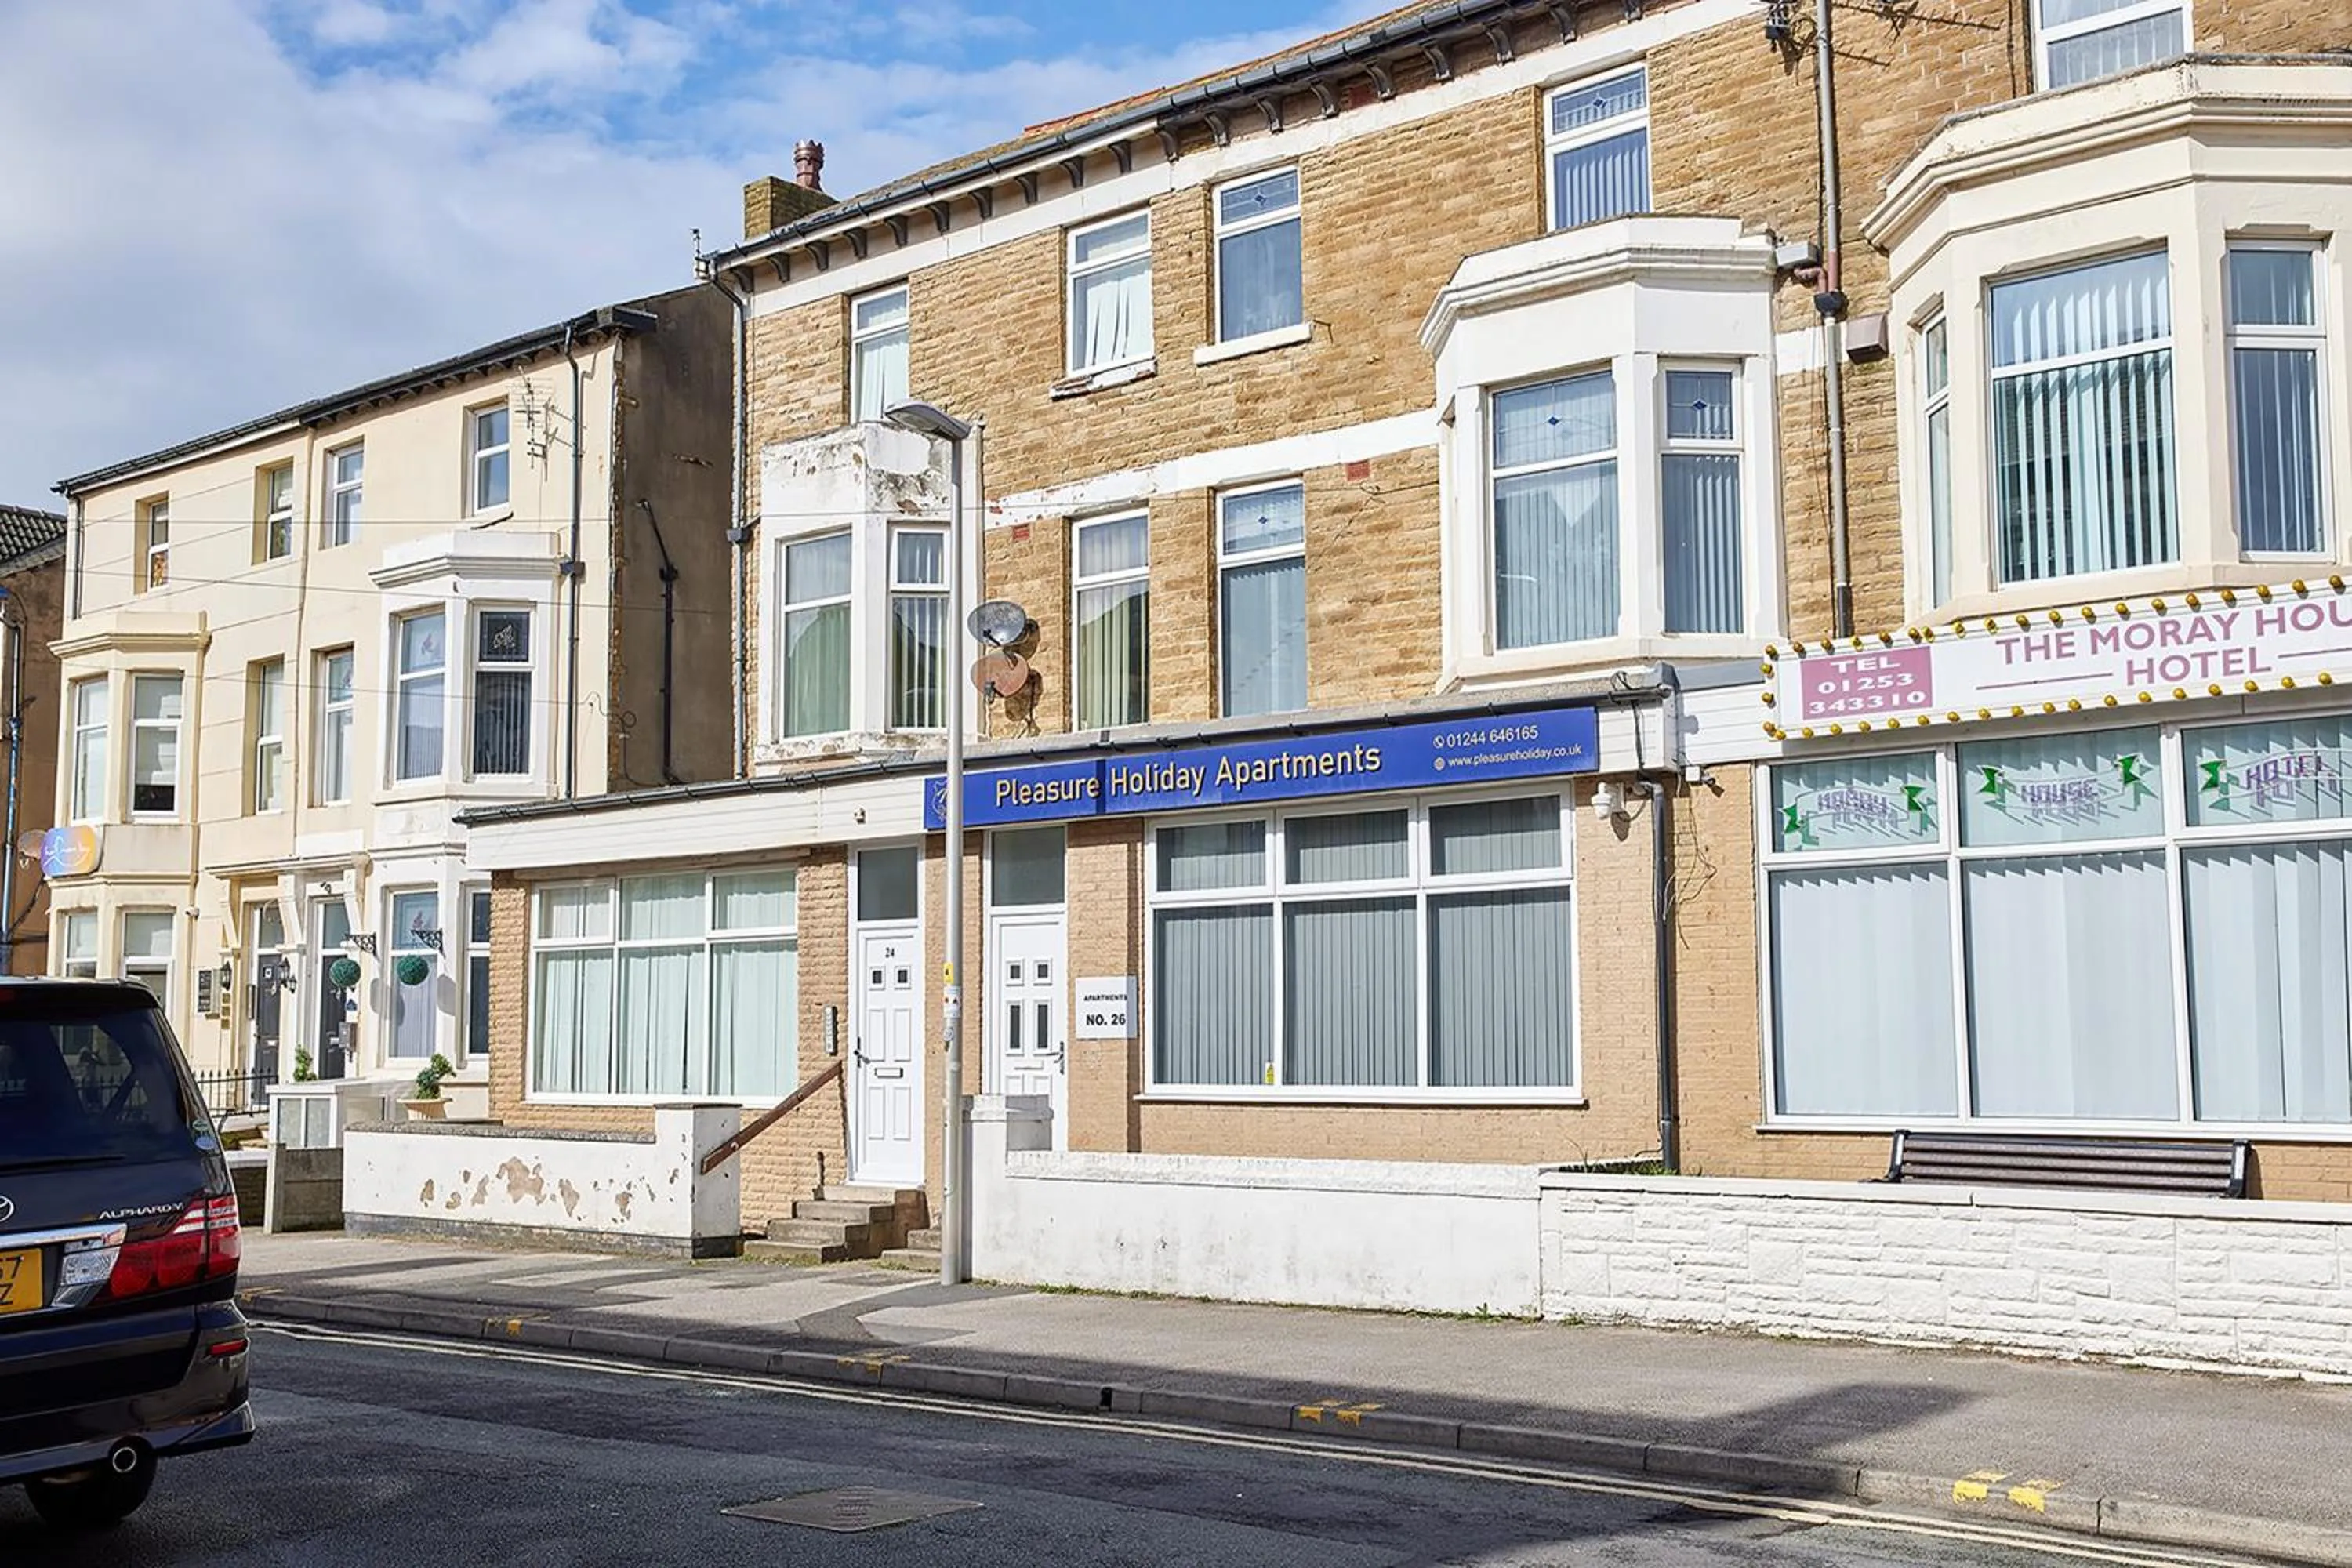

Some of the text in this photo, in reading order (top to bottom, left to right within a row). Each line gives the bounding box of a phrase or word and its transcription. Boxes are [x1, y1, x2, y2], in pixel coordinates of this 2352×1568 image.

[1995, 630, 2077, 665] THE
[2090, 611, 2240, 655] MORAY
[1830, 656, 1902, 674] TEL
[2126, 646, 2272, 686] HOTEL
[1817, 673, 1915, 695] 01253
[1809, 691, 1926, 714] 343310
[1446, 724, 1539, 747] 01244 646165
[1447, 743, 1582, 766] www.pleasureholiday.co.uk
[996, 743, 1382, 808] Pleasure Holiday Apartments
[884, 946, 895, 958] 24
[1086, 1013, 1127, 1026] NO. 26
[99, 1204, 172, 1220] ALPHARD
